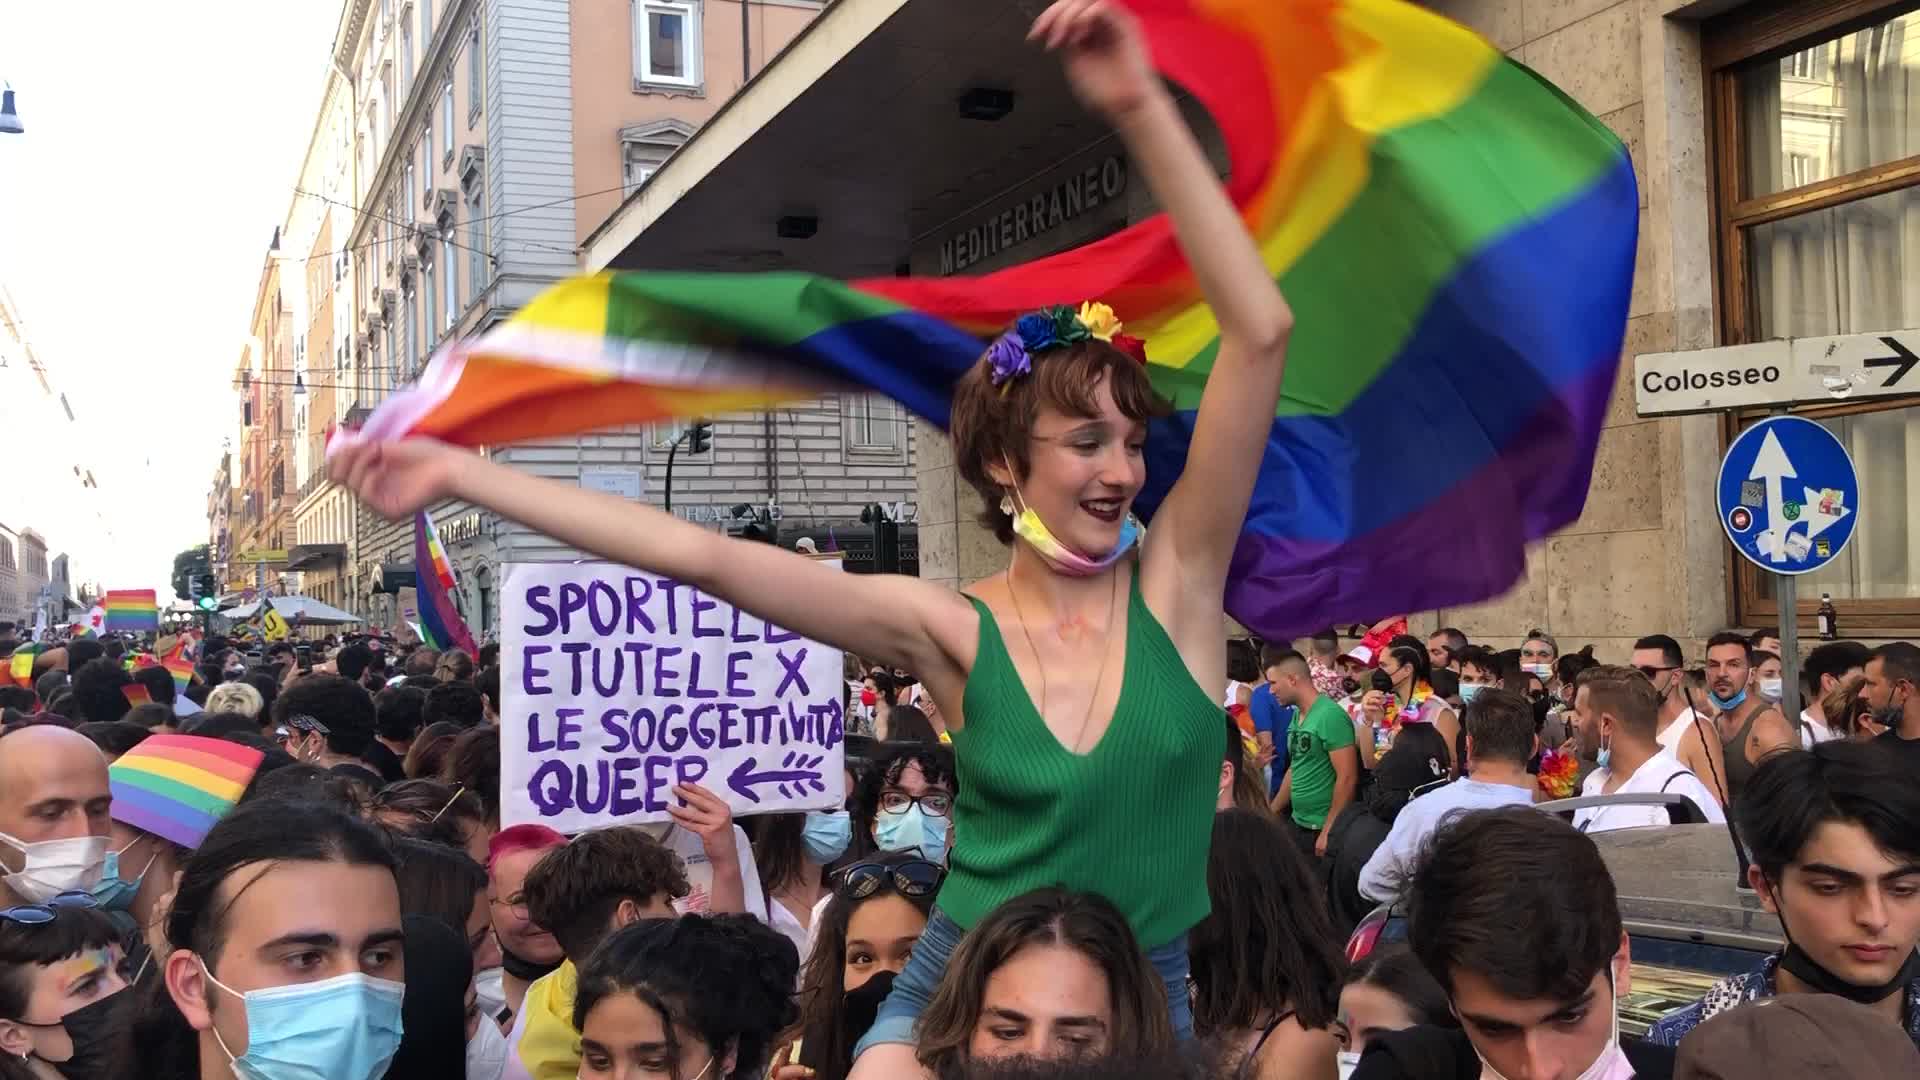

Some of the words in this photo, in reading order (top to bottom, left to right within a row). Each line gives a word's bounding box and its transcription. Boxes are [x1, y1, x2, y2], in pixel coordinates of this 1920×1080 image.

[940, 156, 1120, 275] MEDITERRANEO
[1642, 365, 1780, 393] Colosseo
[775, 647, 810, 699] X
[527, 708, 584, 752] LE
